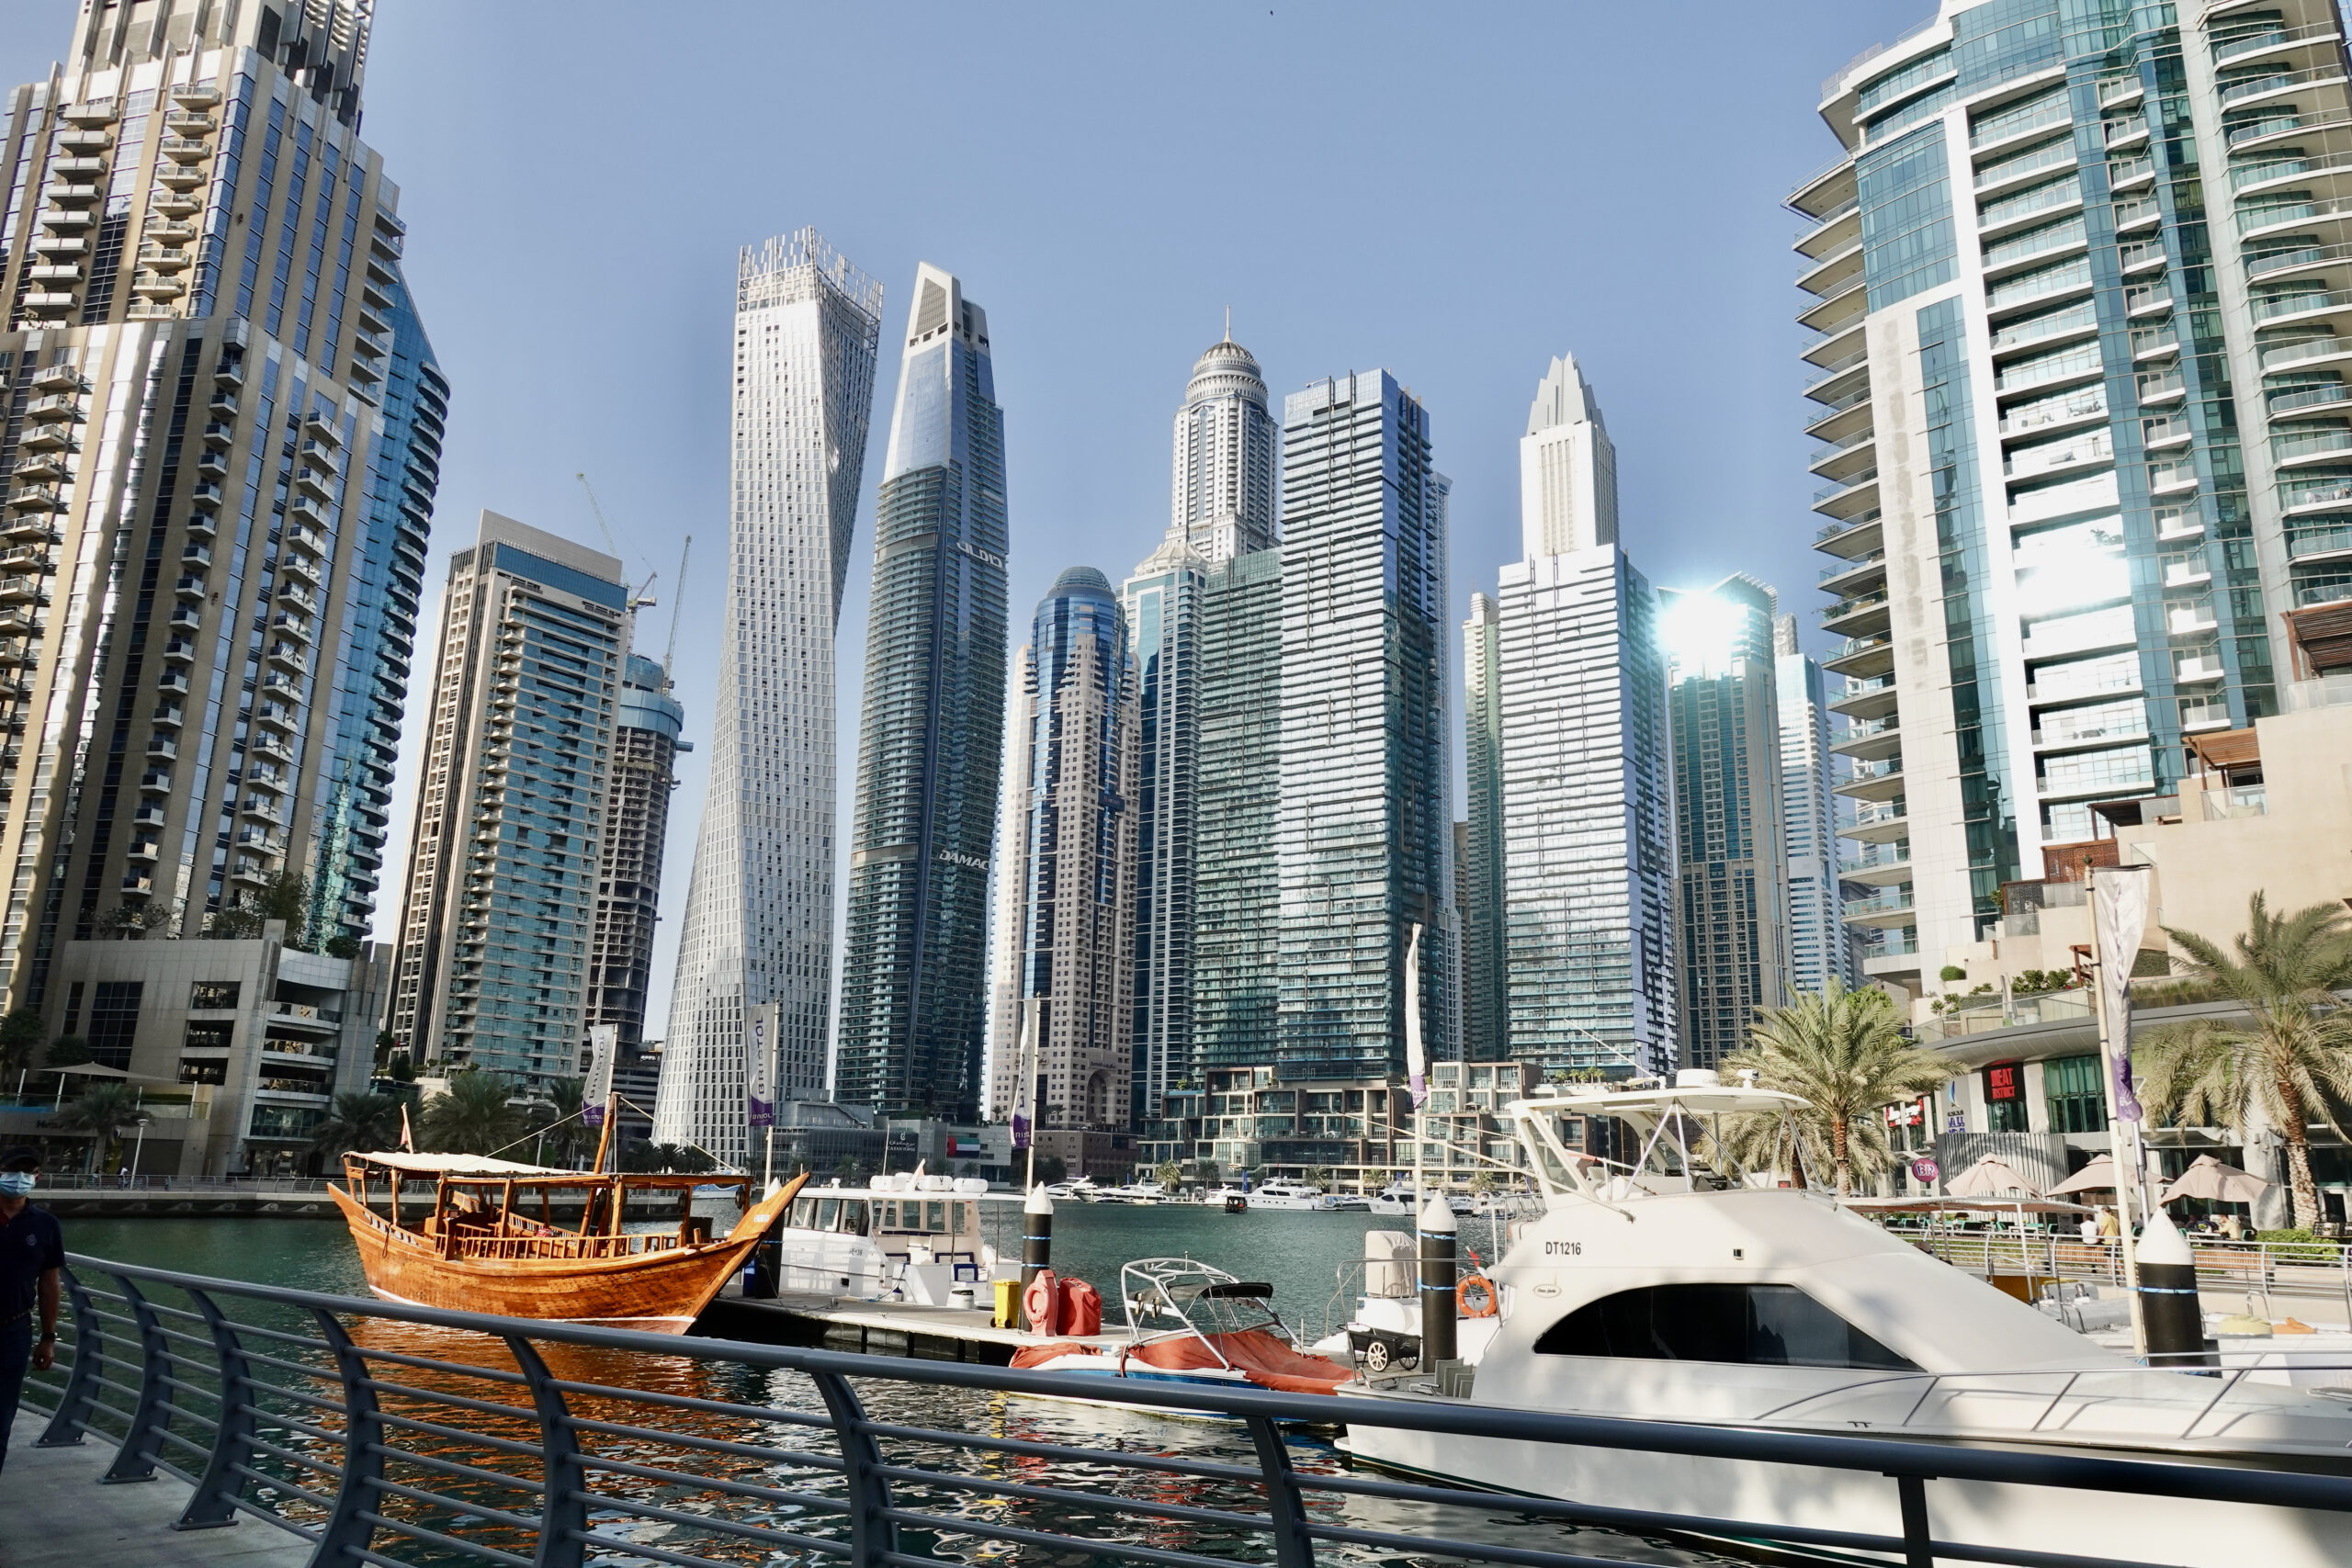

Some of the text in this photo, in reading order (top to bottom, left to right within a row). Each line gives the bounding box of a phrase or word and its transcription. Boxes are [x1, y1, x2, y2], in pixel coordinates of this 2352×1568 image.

[939, 850, 989, 871] DAMAC
[755, 1015, 764, 1094] BRISTOL
[1917, 1164, 1935, 1176] BR
[1545, 1241, 1581, 1256] DT1216
